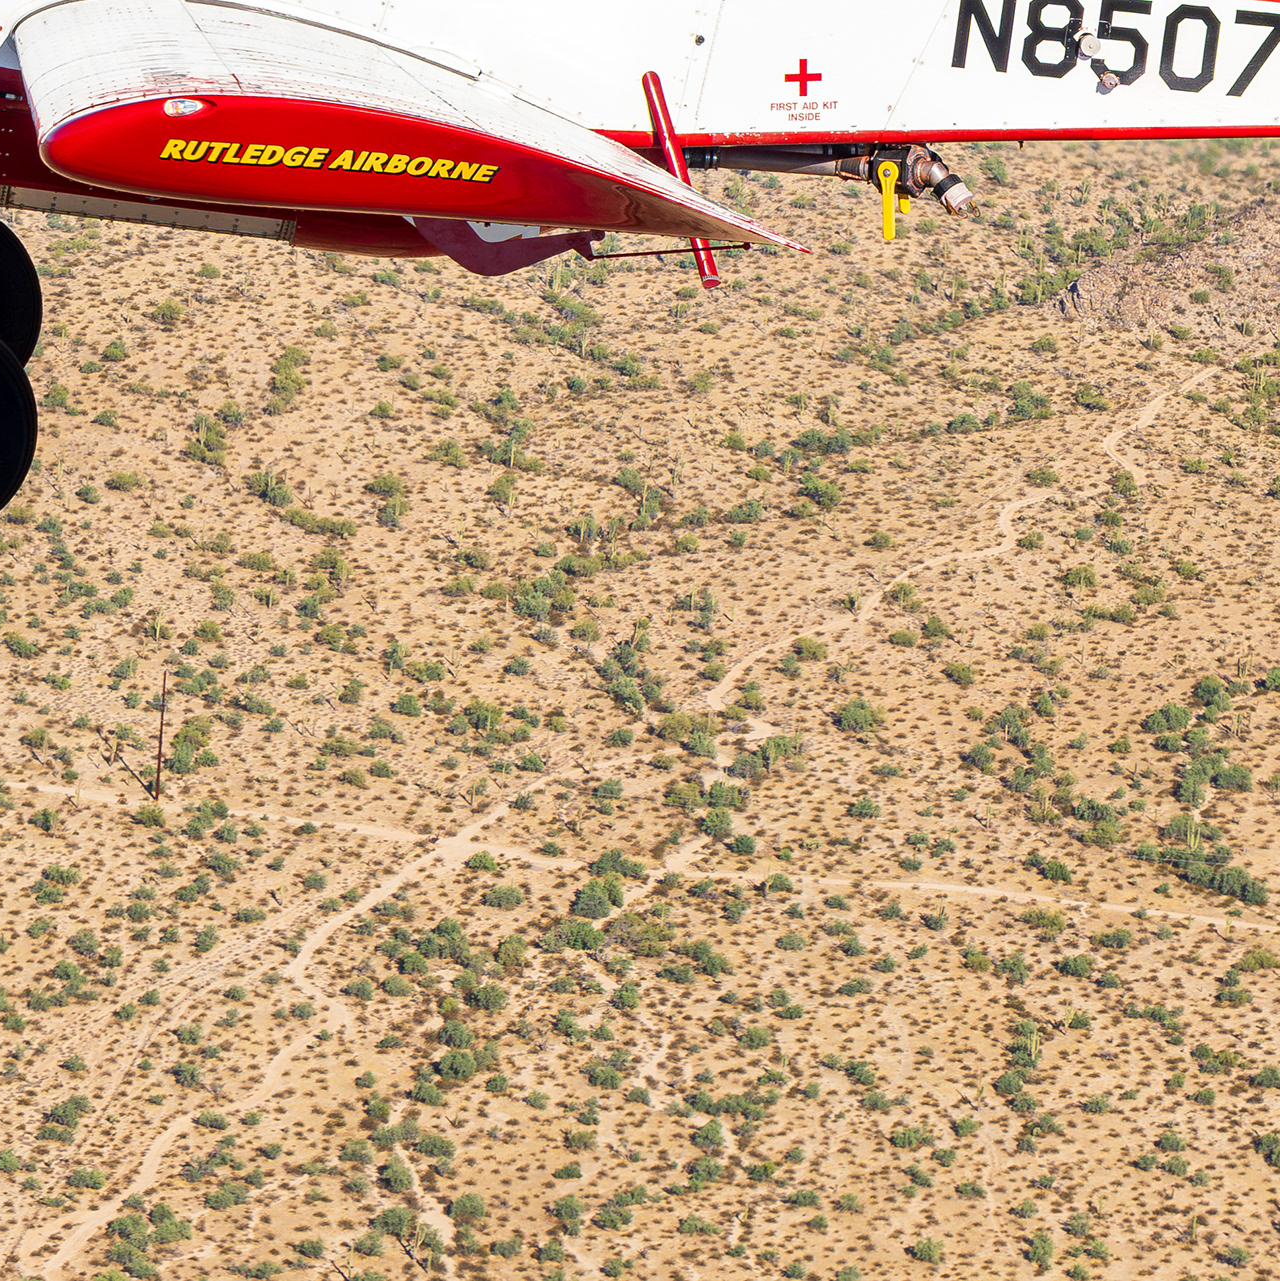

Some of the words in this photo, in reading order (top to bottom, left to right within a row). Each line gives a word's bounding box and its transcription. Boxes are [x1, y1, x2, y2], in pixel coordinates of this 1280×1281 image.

[770, 102, 798, 111] FIRST
[802, 101, 819, 110] AID
[822, 100, 839, 110] KIT
[788, 112, 821, 122] INSIDE
[158, 138, 331, 171] RUTLEDGE
[328, 149, 502, 184] AIRBORNE
